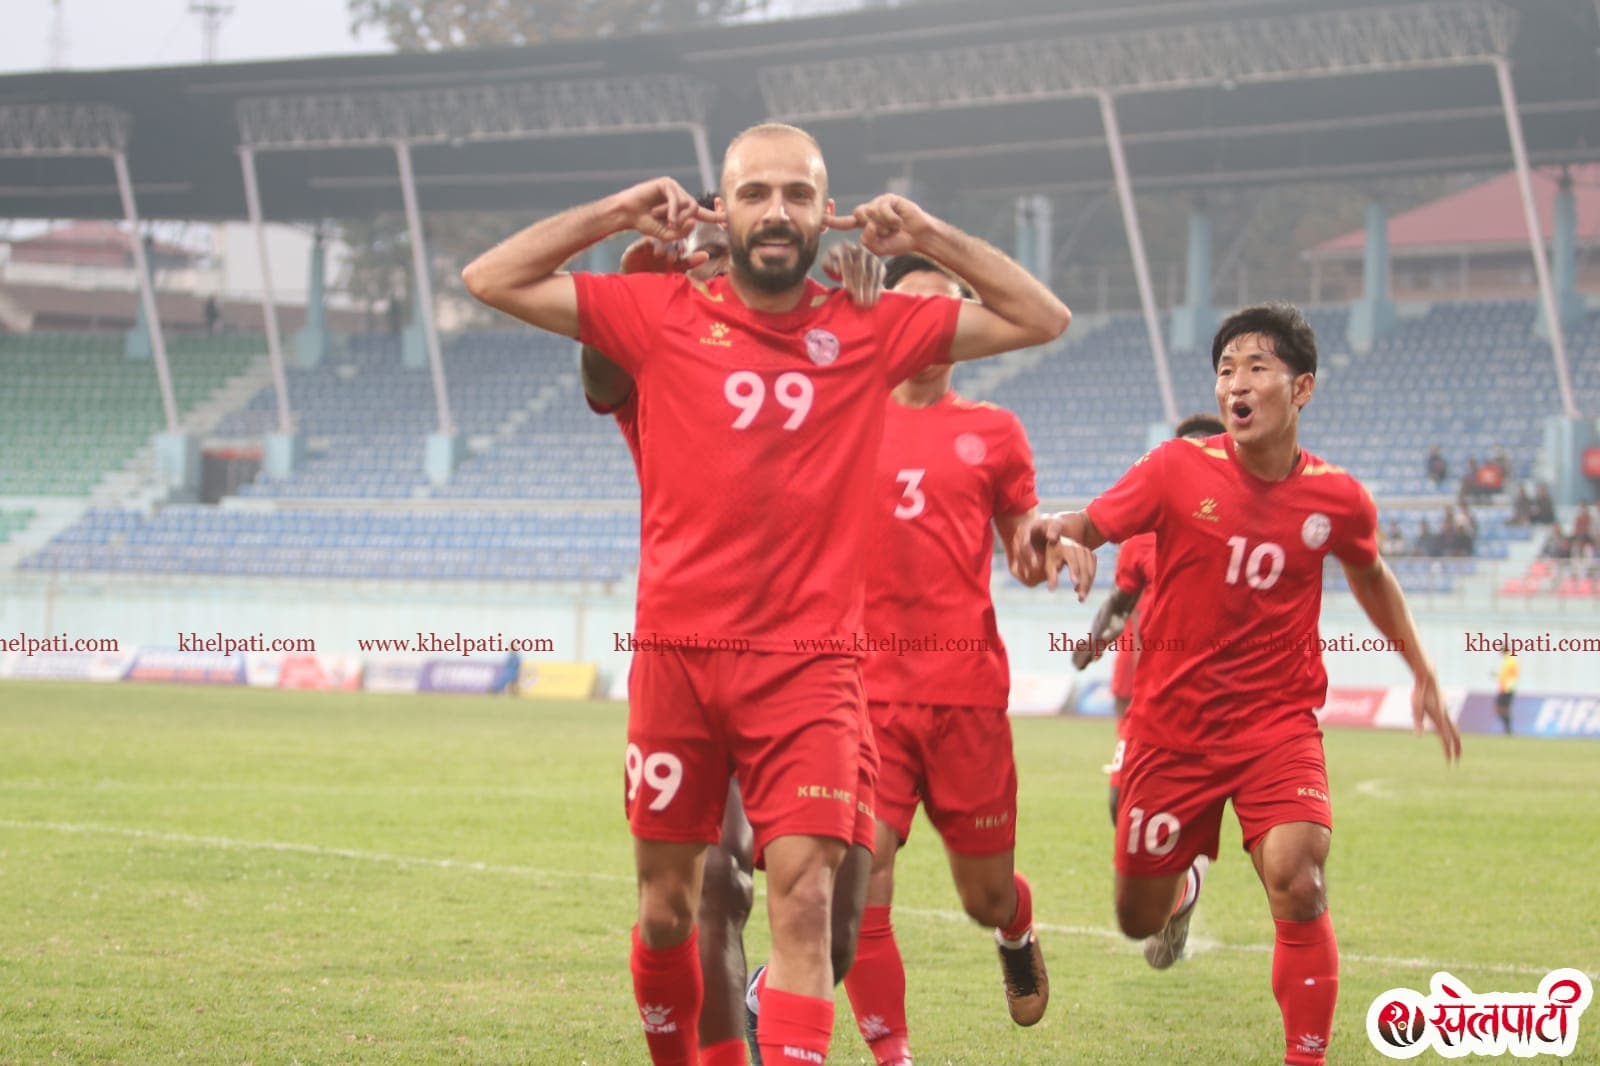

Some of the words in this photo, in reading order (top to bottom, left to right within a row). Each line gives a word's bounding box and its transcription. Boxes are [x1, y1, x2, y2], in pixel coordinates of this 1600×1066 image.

[724, 370, 815, 431] 99
[893, 469, 926, 520] 3
[1225, 536, 1286, 590] 10
[626, 743, 683, 811] 99
[798, 785, 852, 804] KELME
[1126, 808, 1181, 856] 10
